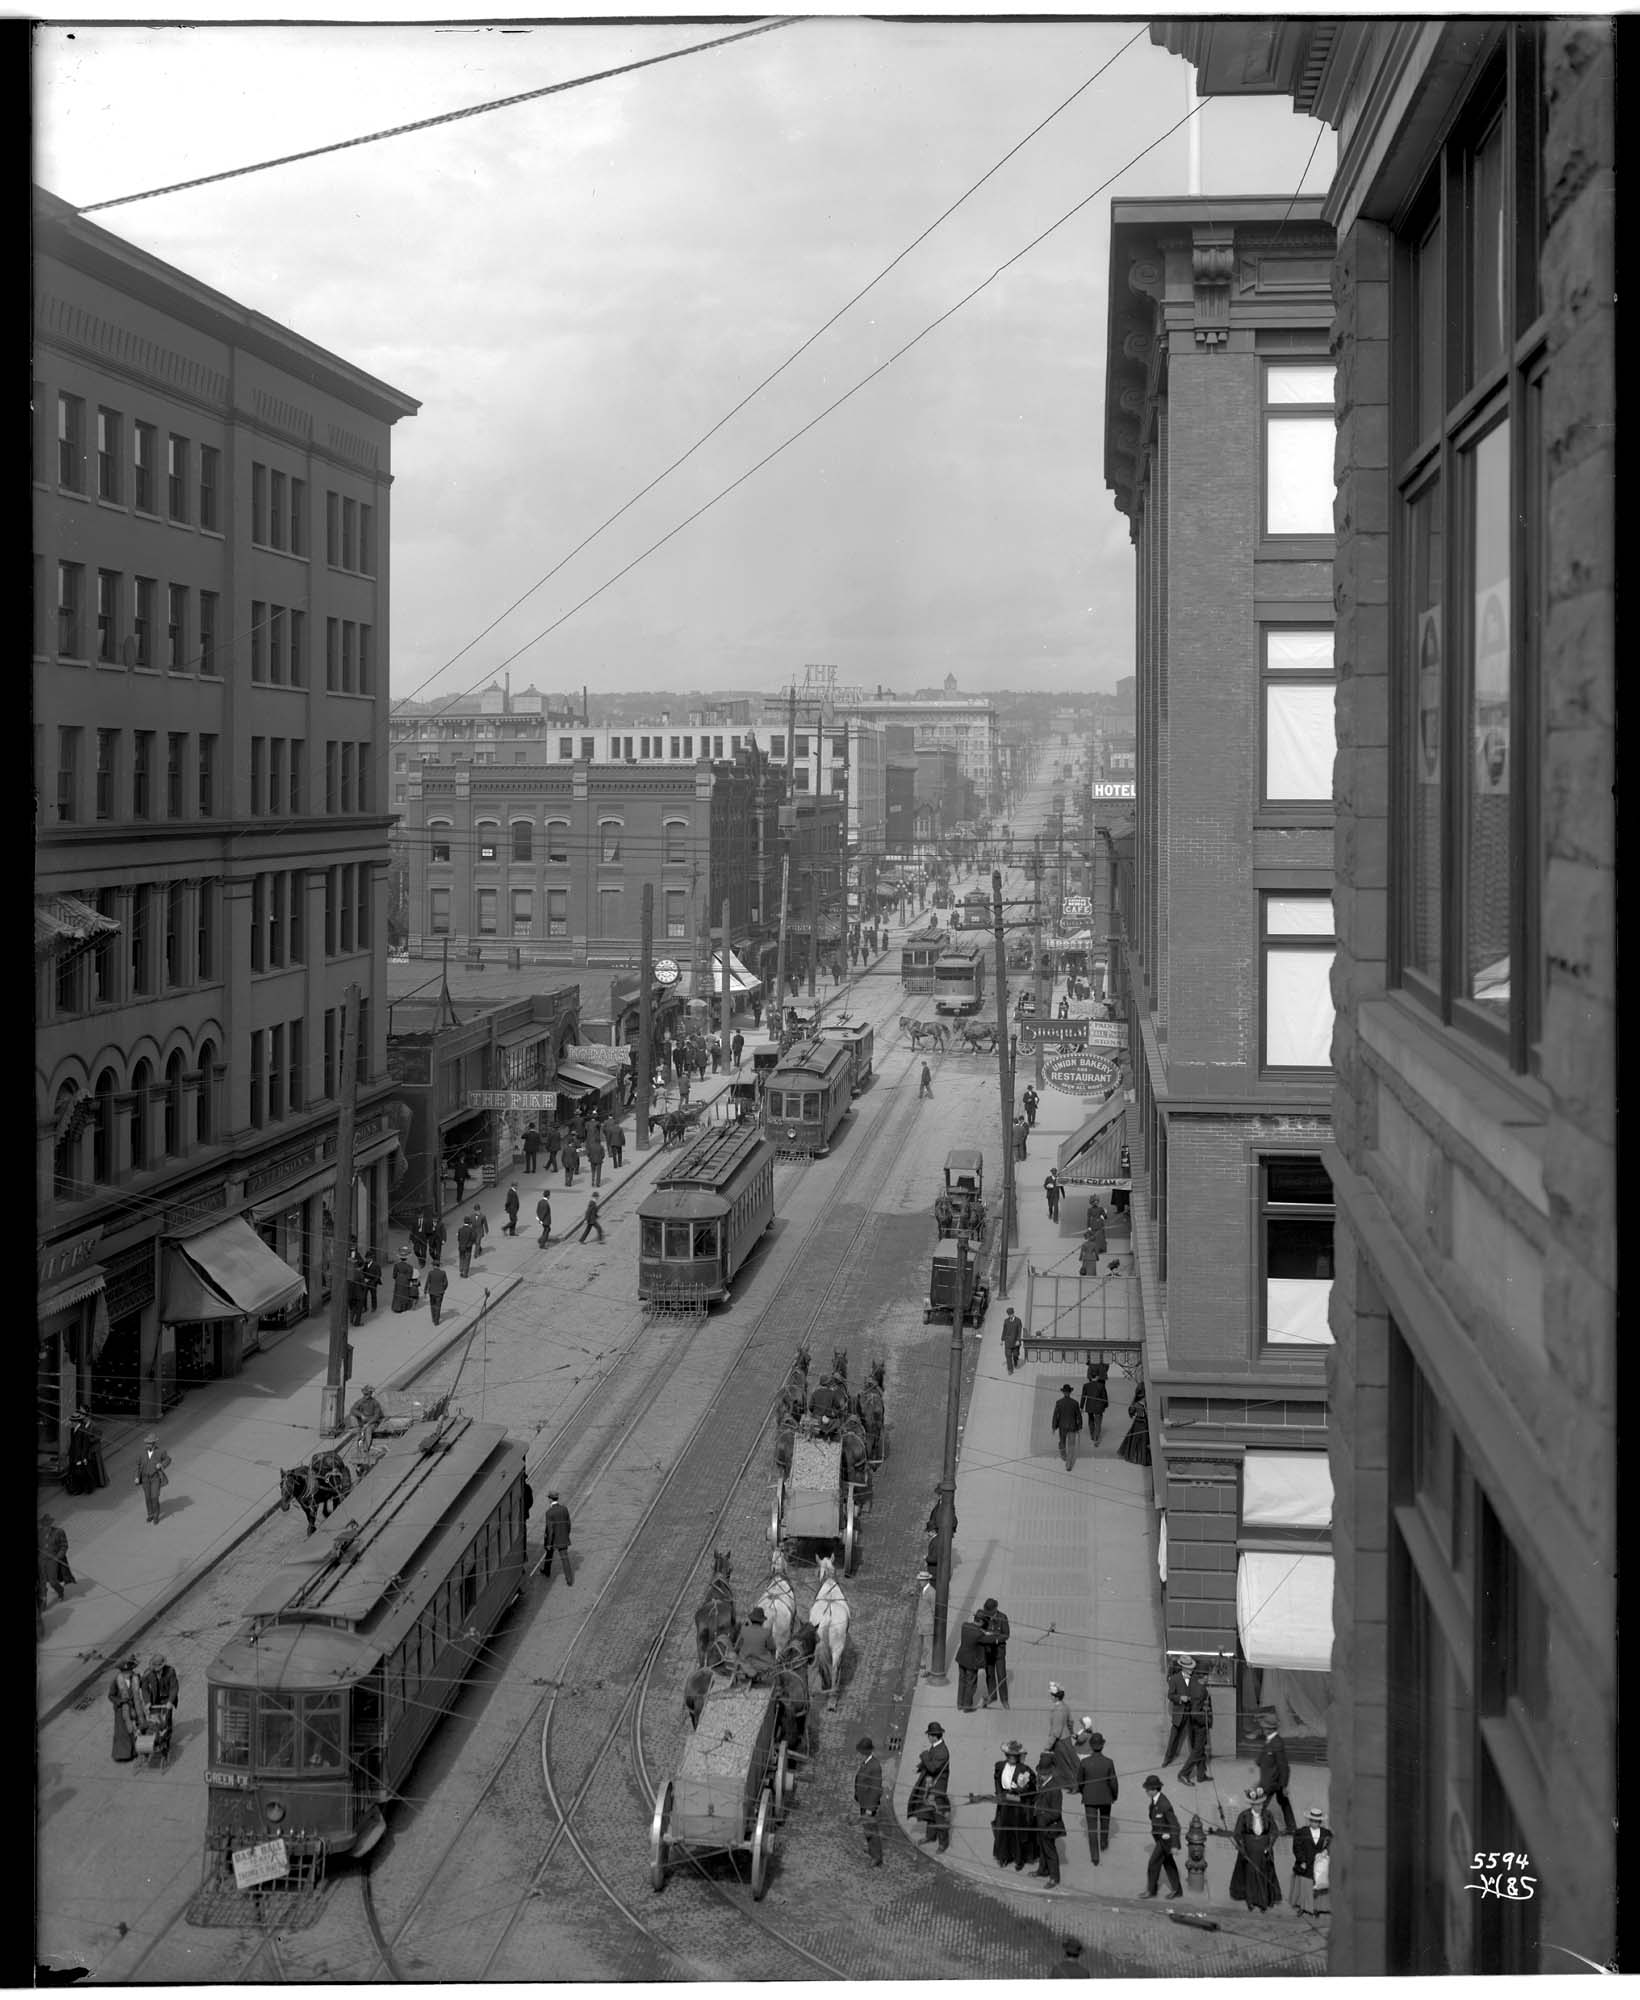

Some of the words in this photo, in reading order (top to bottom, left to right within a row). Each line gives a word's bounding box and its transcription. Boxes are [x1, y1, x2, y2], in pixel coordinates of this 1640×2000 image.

[804, 664, 839, 681] THE
[1095, 784, 1136, 796] HOTEL
[1065, 905, 1090, 913] CAFE
[1052, 1058, 1077, 1073] UNION
[1080, 1058, 1113, 1075] BAKERY
[1051, 1072, 1112, 1082] RESTAURANT
[470, 1093, 506, 1107] THE
[511, 1093, 554, 1108] PIKE
